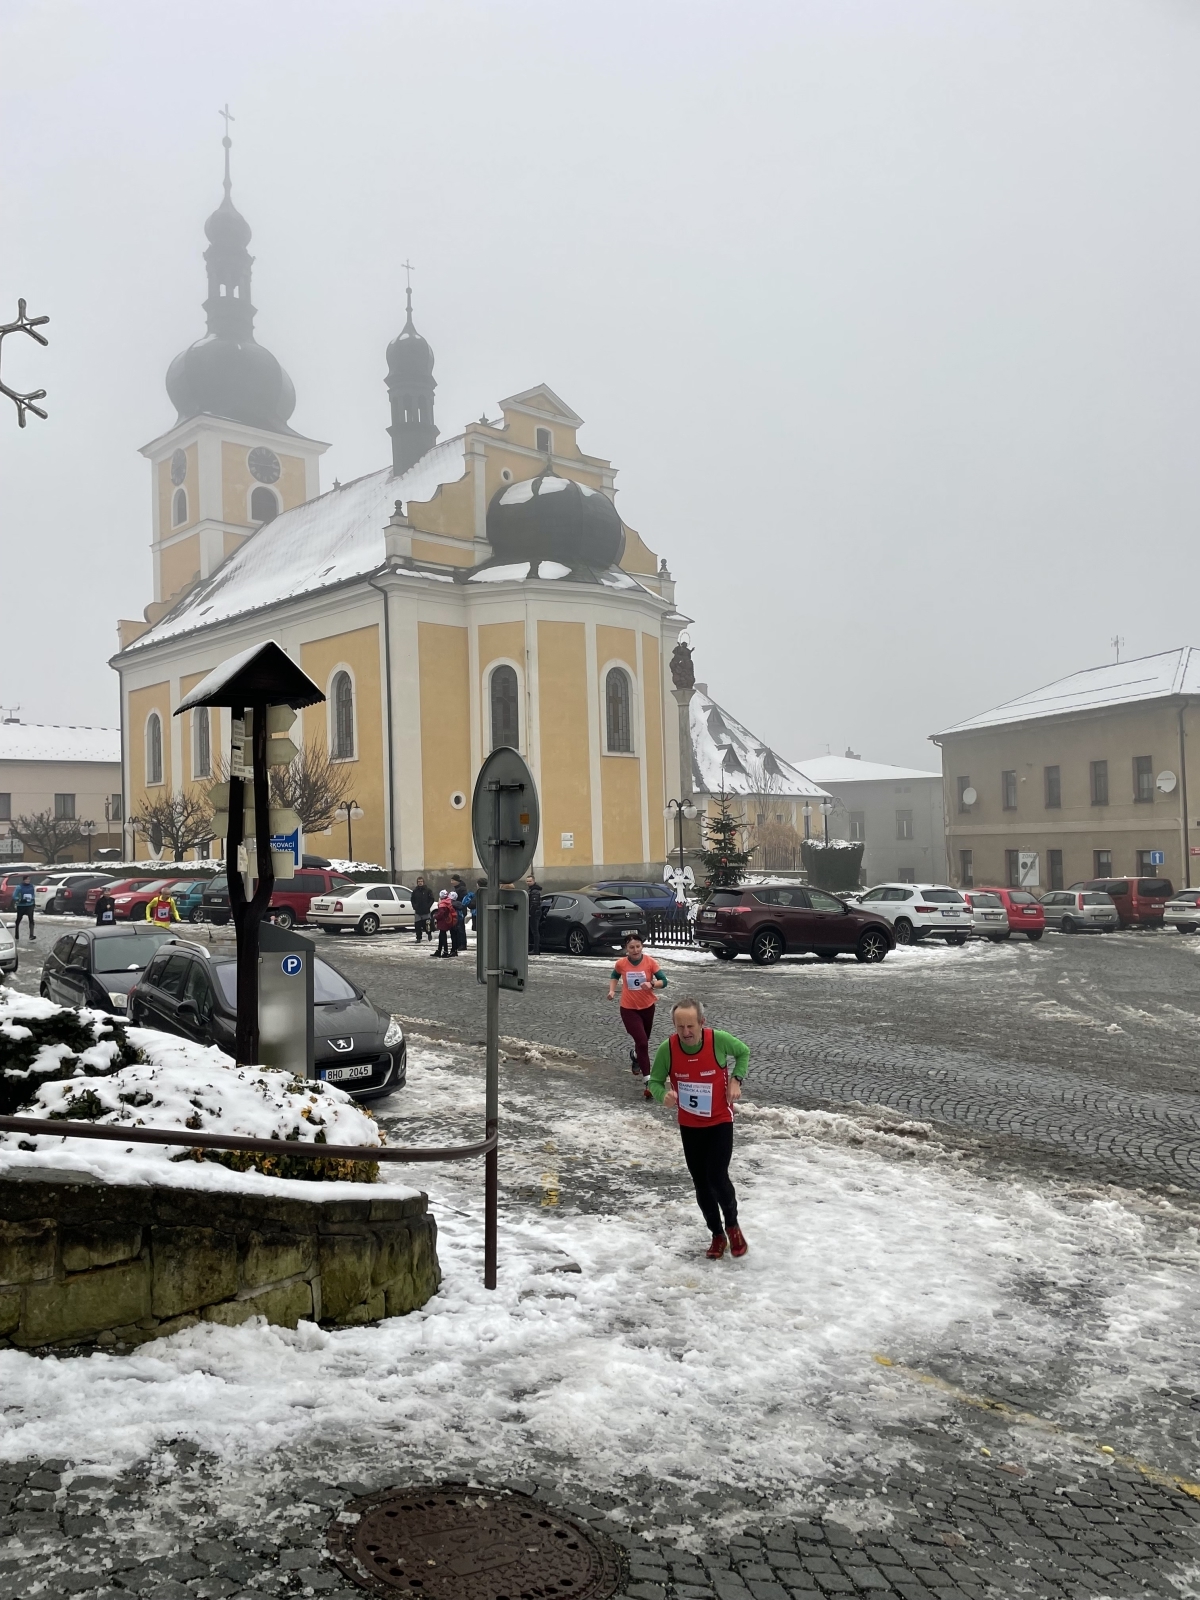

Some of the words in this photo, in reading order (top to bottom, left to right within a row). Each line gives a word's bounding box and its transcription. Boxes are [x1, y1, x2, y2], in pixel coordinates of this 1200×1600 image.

[287, 958, 298, 972] P
[634, 979, 640, 987] 6
[349, 1065, 369, 1078] 2045
[689, 1095, 699, 1108] 5
